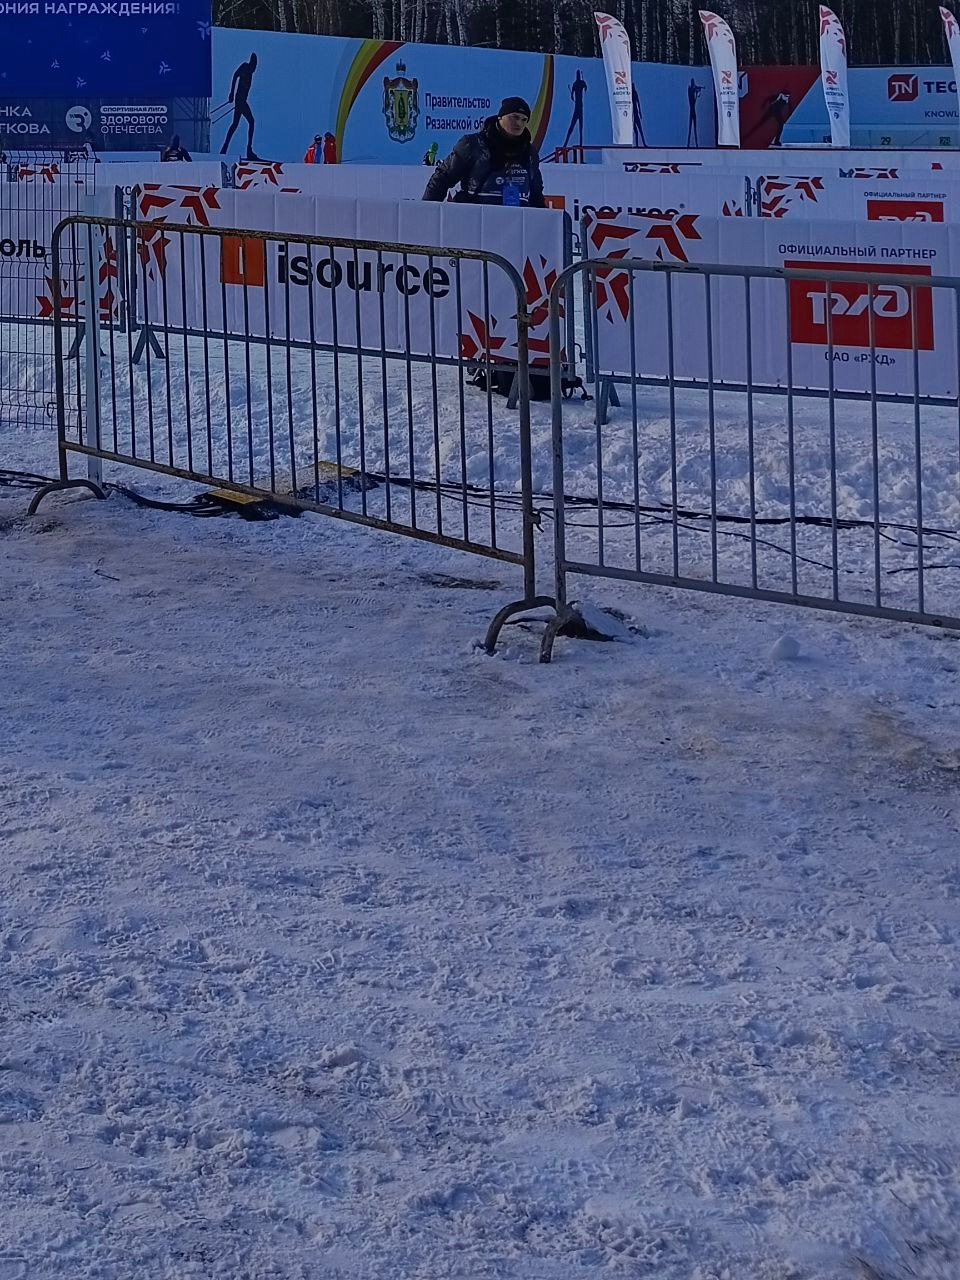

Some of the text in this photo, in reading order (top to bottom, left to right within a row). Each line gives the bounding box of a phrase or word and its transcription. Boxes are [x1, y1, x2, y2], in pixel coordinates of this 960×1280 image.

[44, 2, 180, 16] НАГРАЖДЕНИЯ!
[923, 80, 958, 94] TEC
[424, 92, 491, 111] Правительство
[100, 115, 168, 125] ЗДОРОВОГО
[924, 110, 959, 118] KNOWL
[425, 115, 472, 130] Рязанской
[100, 125, 163, 134] ОТЕЧЕСТВА
[880, 136, 891, 146] 29
[778, 243, 937, 260] ОФИЦИАЛЬНЫЙ ПАРТНЕР
[824, 351, 850, 362] ОАО
